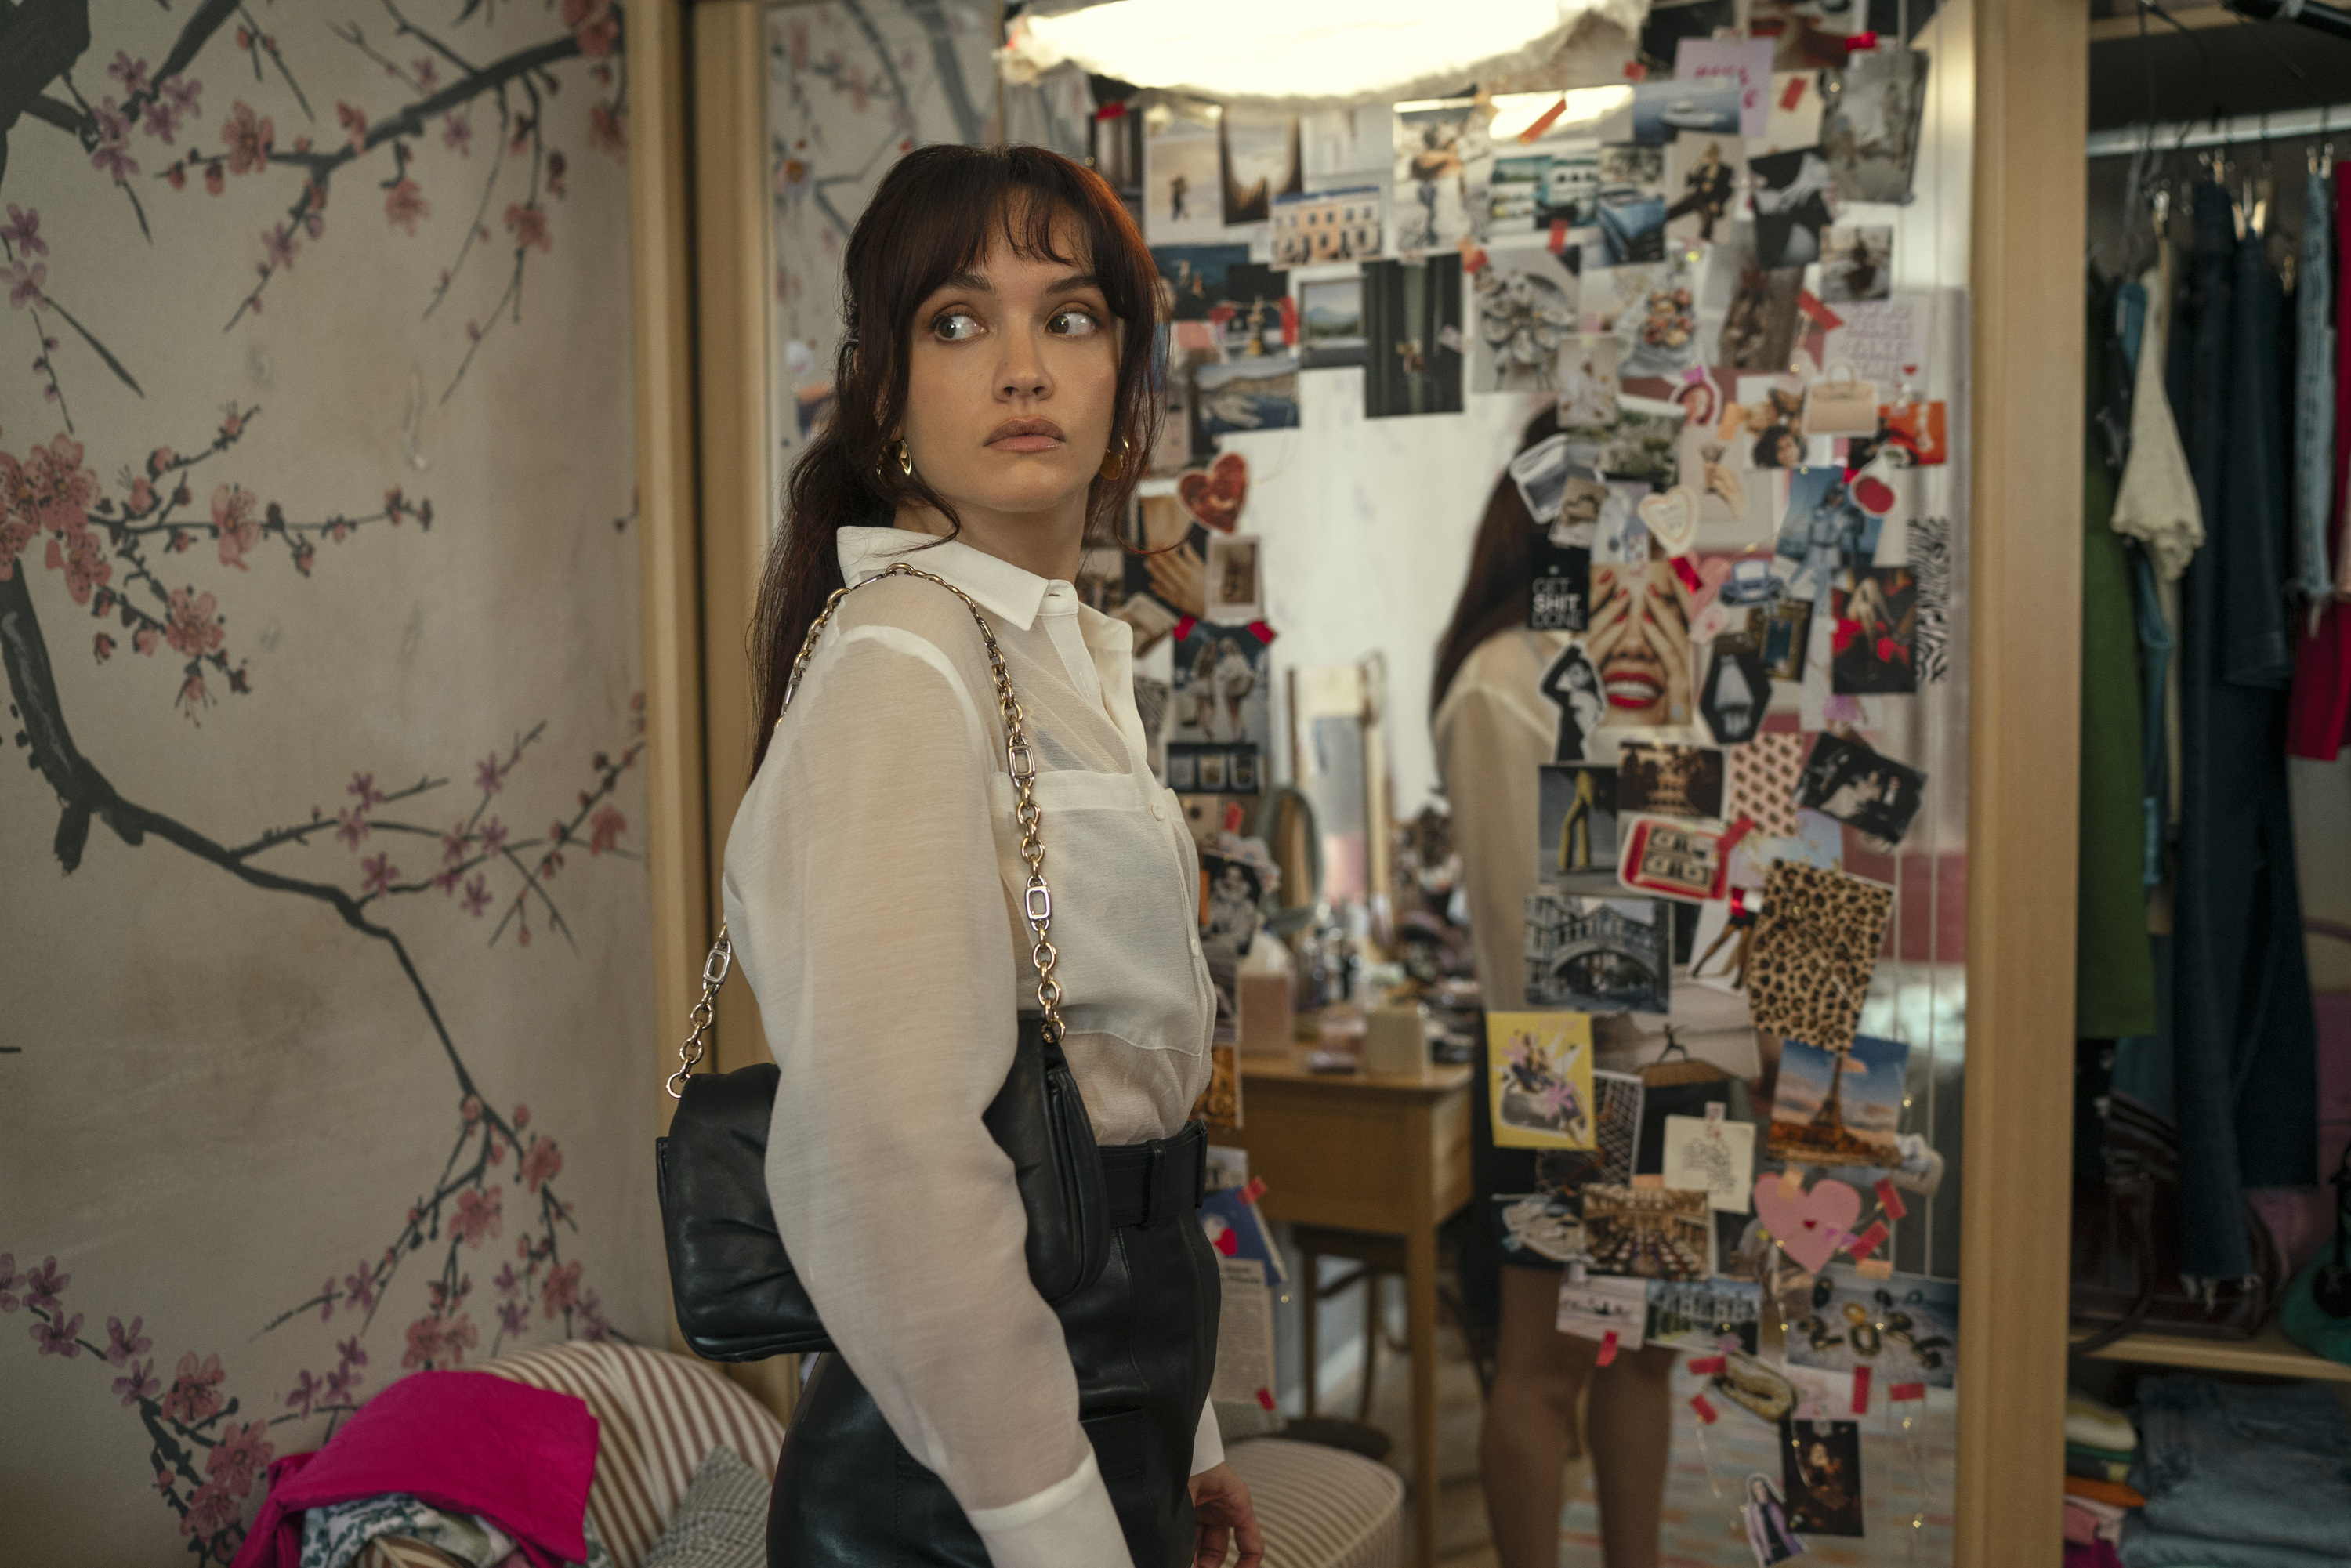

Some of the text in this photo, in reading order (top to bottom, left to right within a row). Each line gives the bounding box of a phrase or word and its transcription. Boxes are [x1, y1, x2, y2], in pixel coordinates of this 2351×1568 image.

[1532, 577, 1570, 595] GET
[1533, 593, 1580, 613] SHIT
[1532, 611, 1583, 629] DONE
